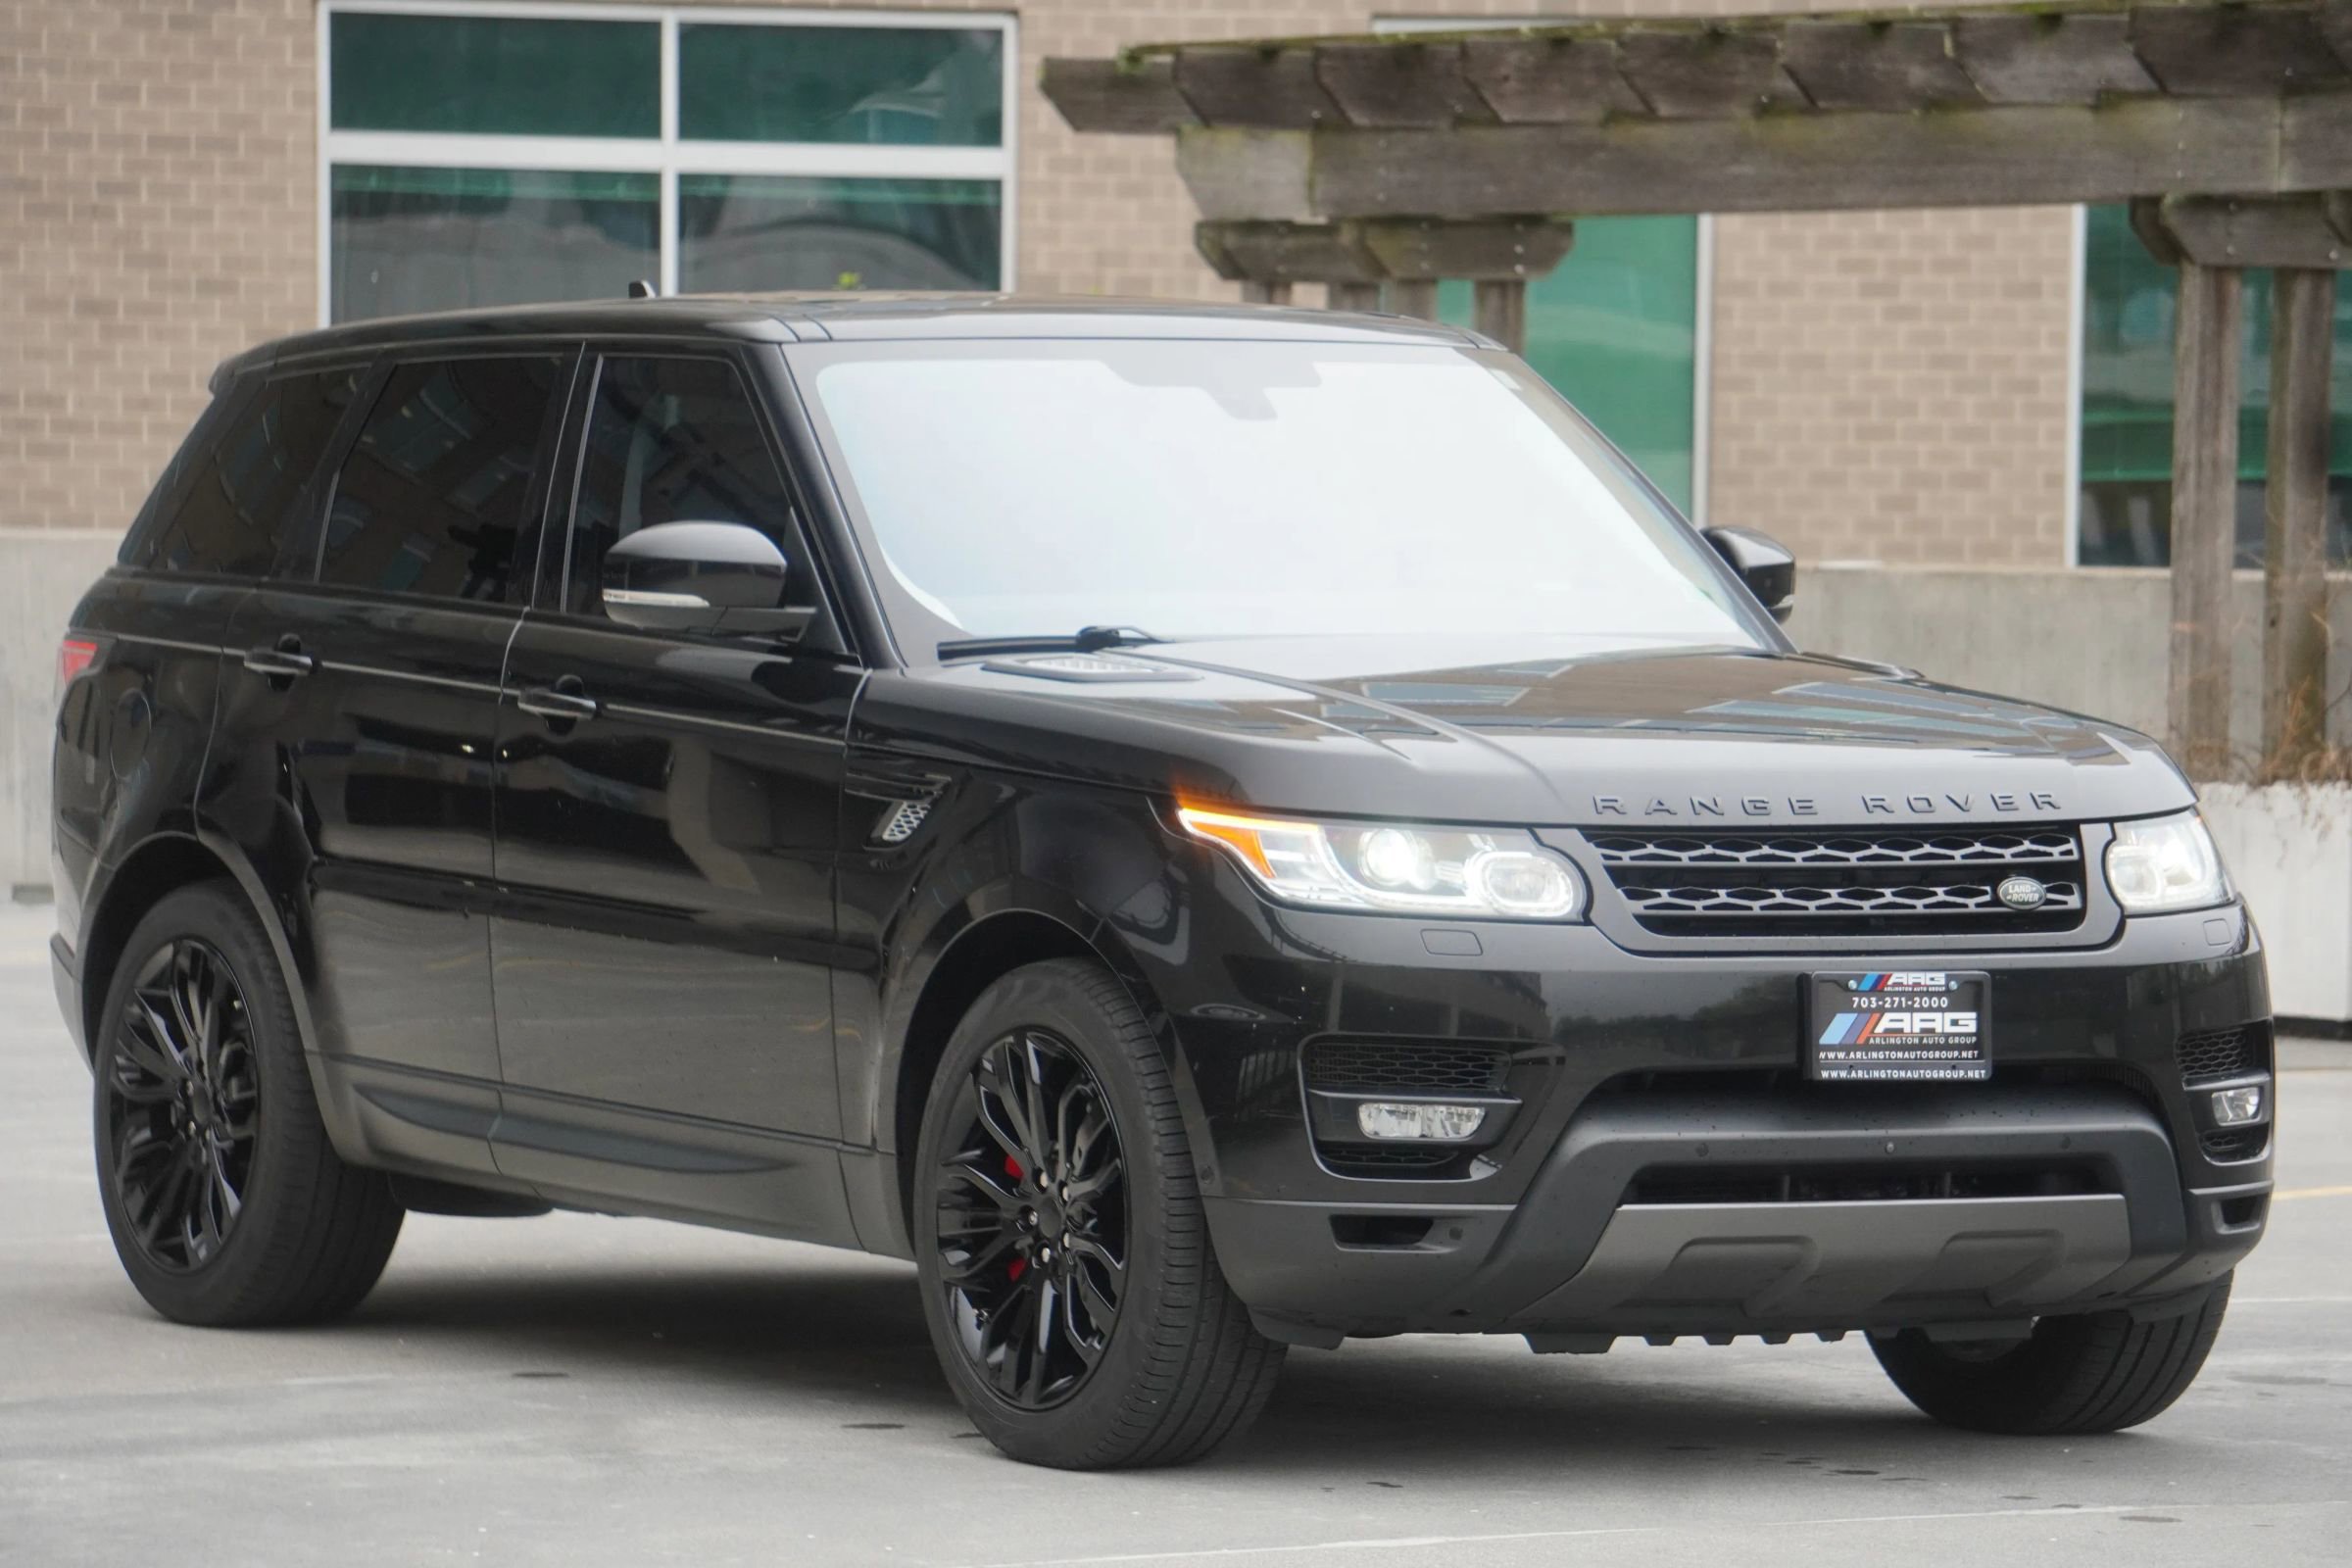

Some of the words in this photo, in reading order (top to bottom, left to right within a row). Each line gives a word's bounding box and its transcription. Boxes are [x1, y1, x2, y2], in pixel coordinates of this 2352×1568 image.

[1592, 795, 1819, 816] RANGE
[1861, 791, 2062, 814] ROVER
[2008, 884, 2032, 894] LAND
[2011, 893, 2039, 903] ROVER
[1886, 972, 1945, 986] AAG
[1852, 997, 1948, 1008] 703-271-2000
[1873, 1011, 1978, 1034] AAG
[1922, 1036, 1945, 1045] AUTO
[1948, 1036, 1978, 1045] GROUP
[1821, 1069, 1985, 1079] WWW.ARLINGTONAUTOGROUP.NET
